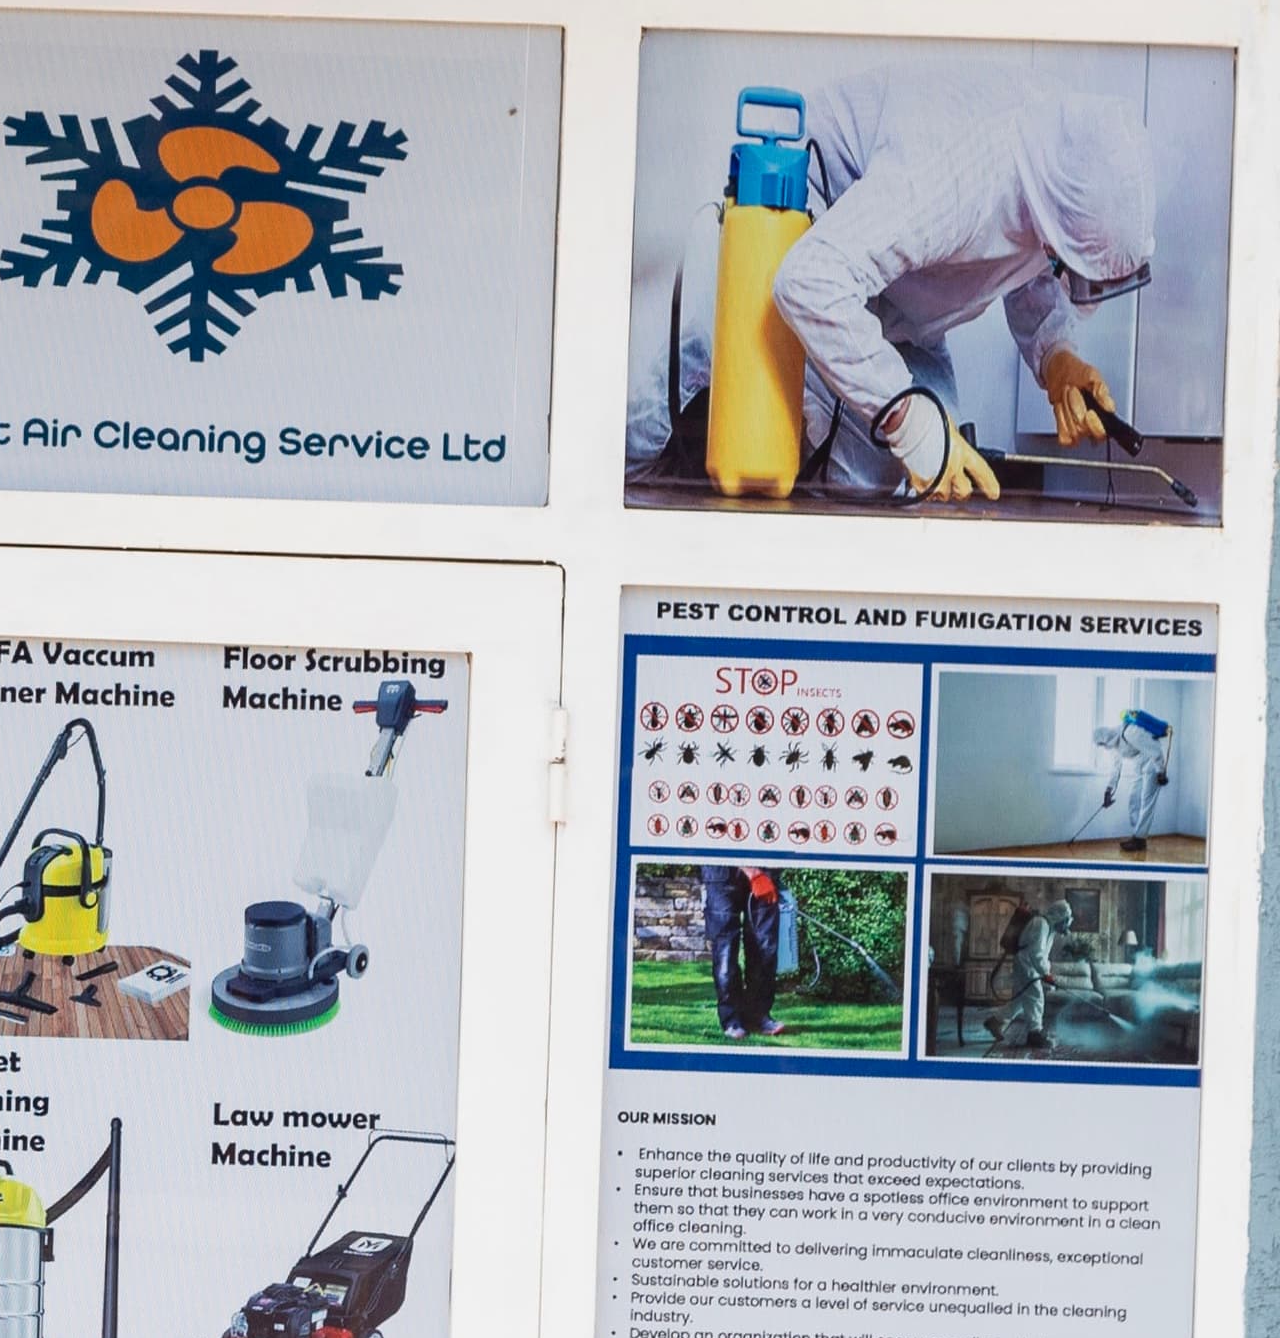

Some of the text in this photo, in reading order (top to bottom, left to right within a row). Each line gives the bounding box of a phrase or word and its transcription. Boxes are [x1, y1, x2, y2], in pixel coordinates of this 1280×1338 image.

[22, 417, 82, 448] Air
[93, 420, 266, 465] Cleaning
[278, 426, 431, 461] Service
[442, 432, 506, 463] Ltd
[657, 601, 1203, 637] PEST CONTROL AND FUMIGATION SERVICES
[42, 641, 155, 668] Vaccum
[223, 645, 446, 680] Floor Scrubbing
[55, 681, 175, 708] Machine
[715, 667, 842, 699] STOP INSECTS
[222, 685, 343, 712] Machine
[213, 1102, 380, 1130] Law mower
[617, 1110, 716, 1126] OUR MISSION
[211, 1141, 332, 1168] Machine
[631, 1272, 999, 1297] Sustainable solutions for a healthier environment.
